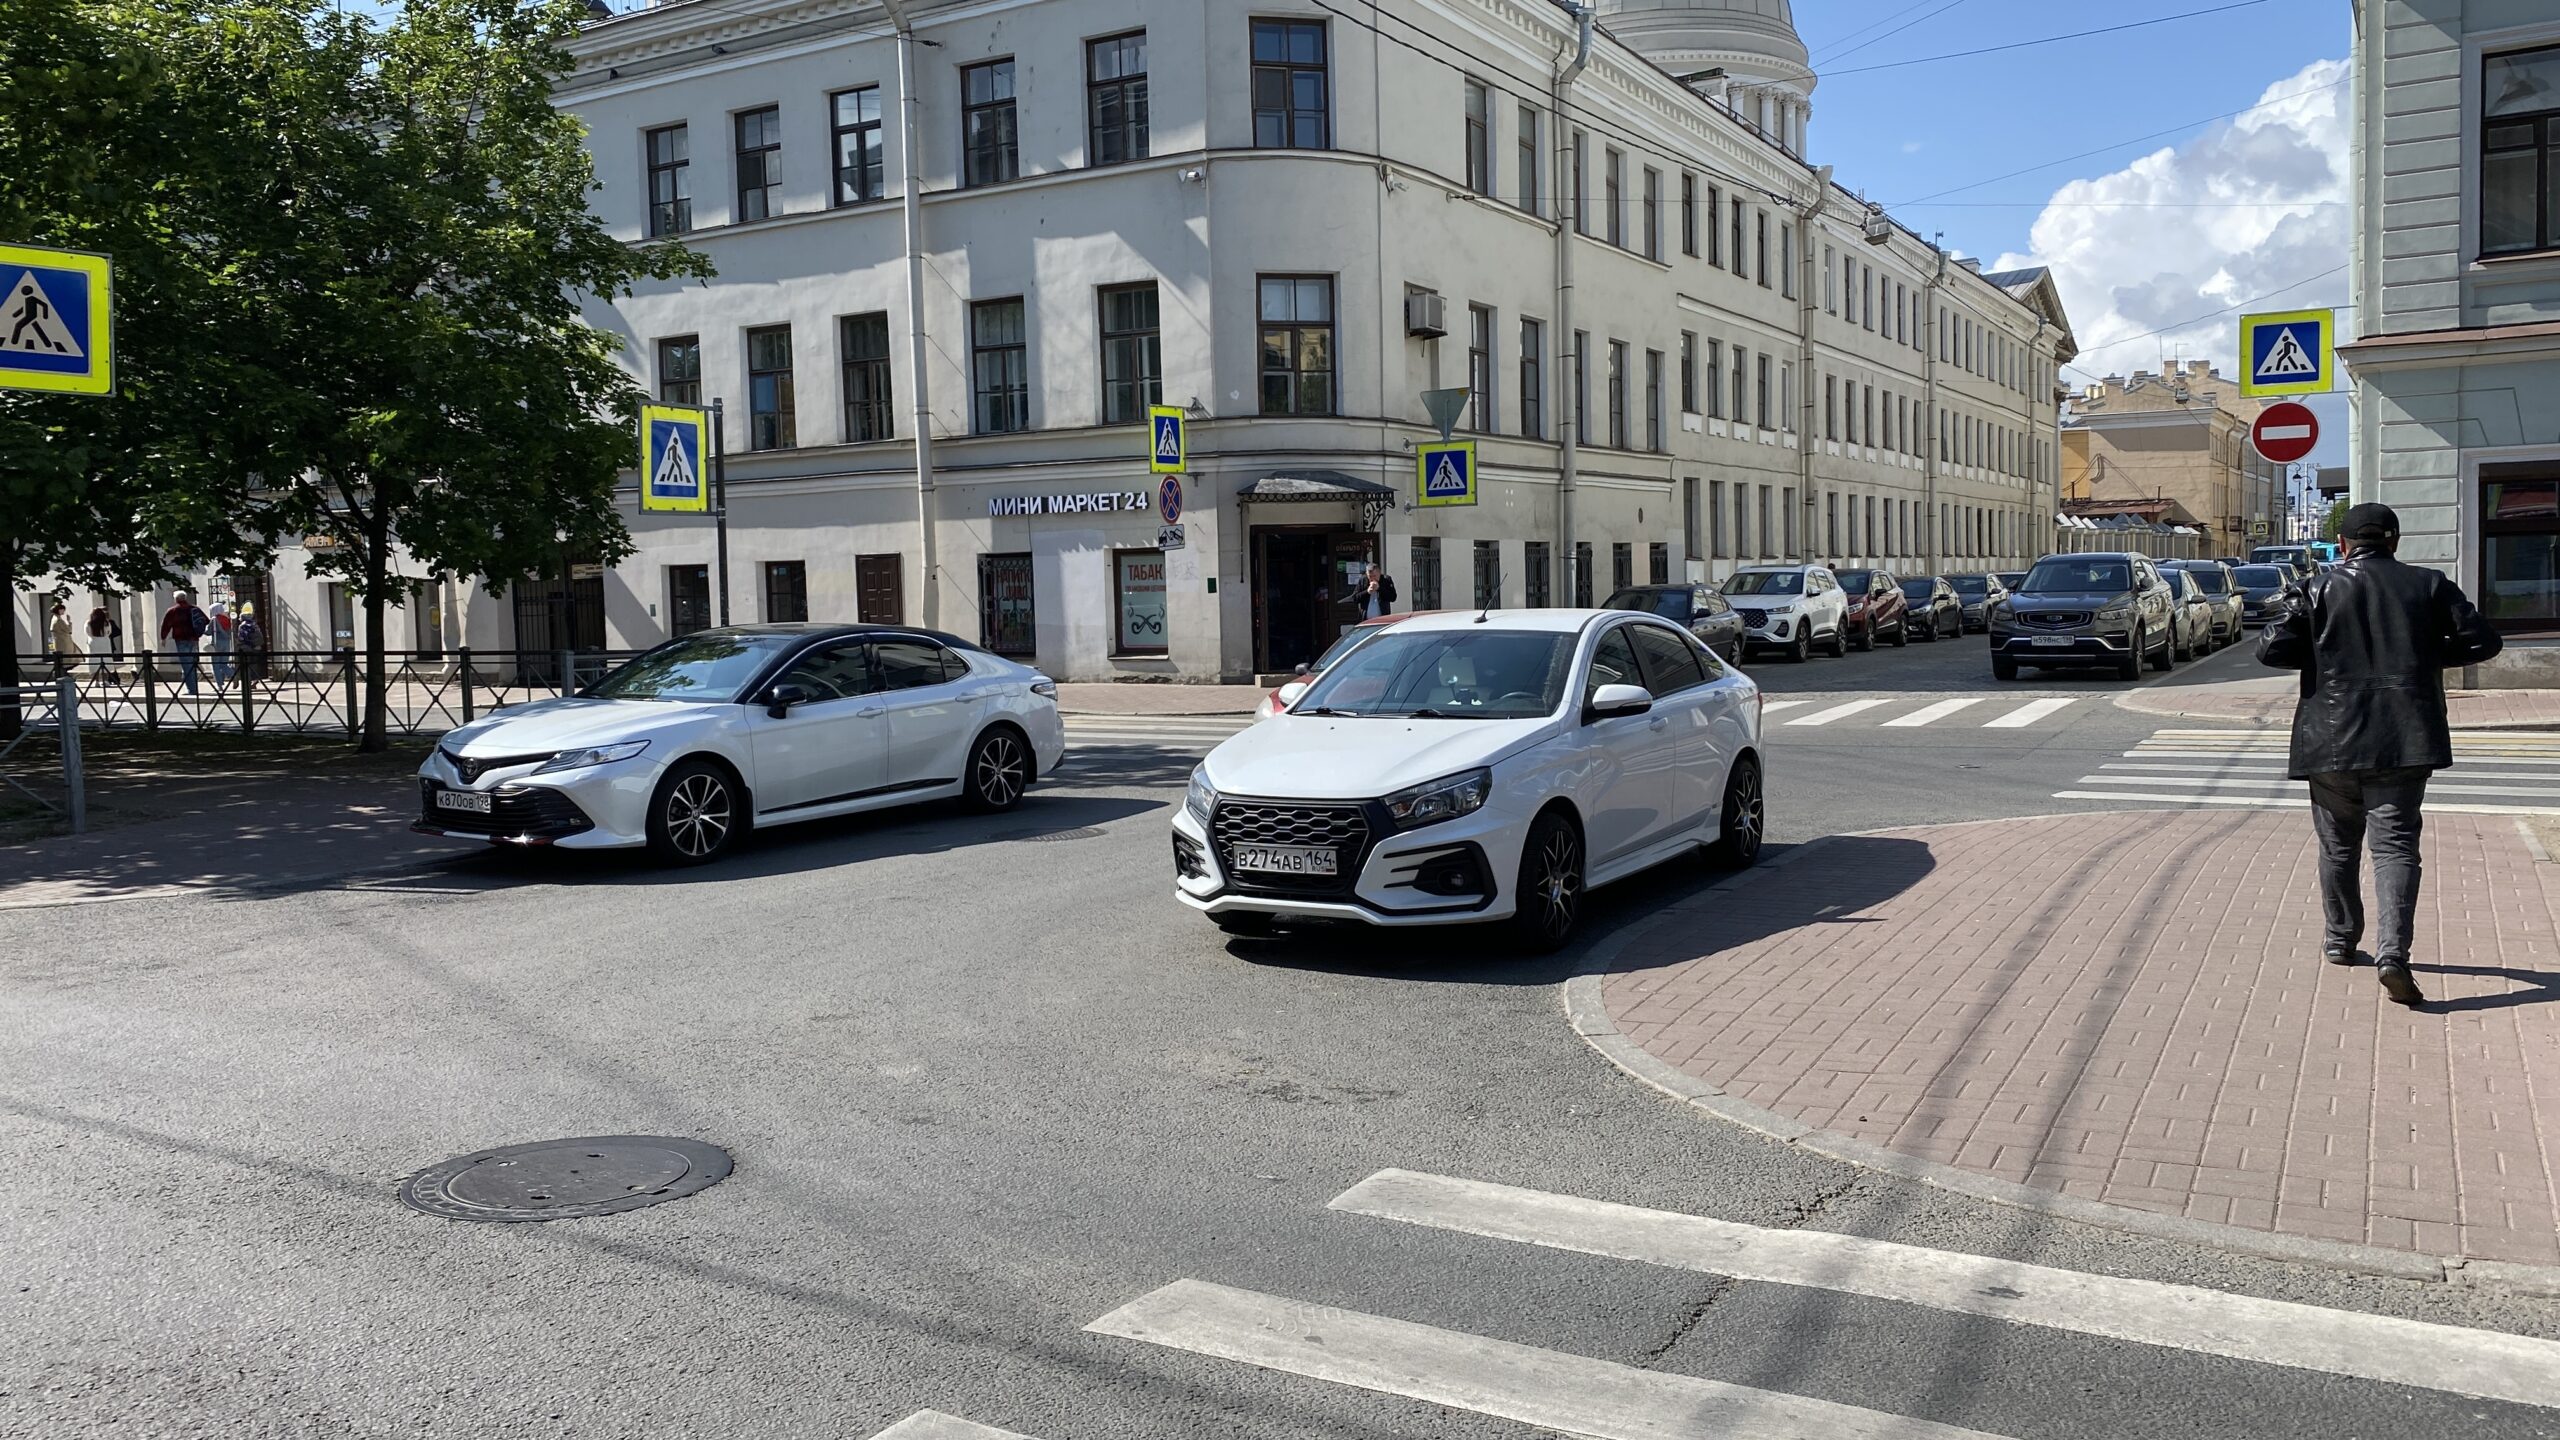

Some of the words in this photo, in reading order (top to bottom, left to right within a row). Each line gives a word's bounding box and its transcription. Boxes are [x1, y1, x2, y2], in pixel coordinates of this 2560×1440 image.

[989, 497, 1042, 516] МИНИ
[1048, 493, 1121, 514] МАРКЕТ
[1124, 492, 1148, 511] 24
[1127, 564, 1163, 581] ТАБАК
[439, 793, 474, 808] К870ОВ
[475, 795, 490, 807] 198
[1238, 849, 1302, 870] В274АВ
[1305, 851, 1331, 866] 164
